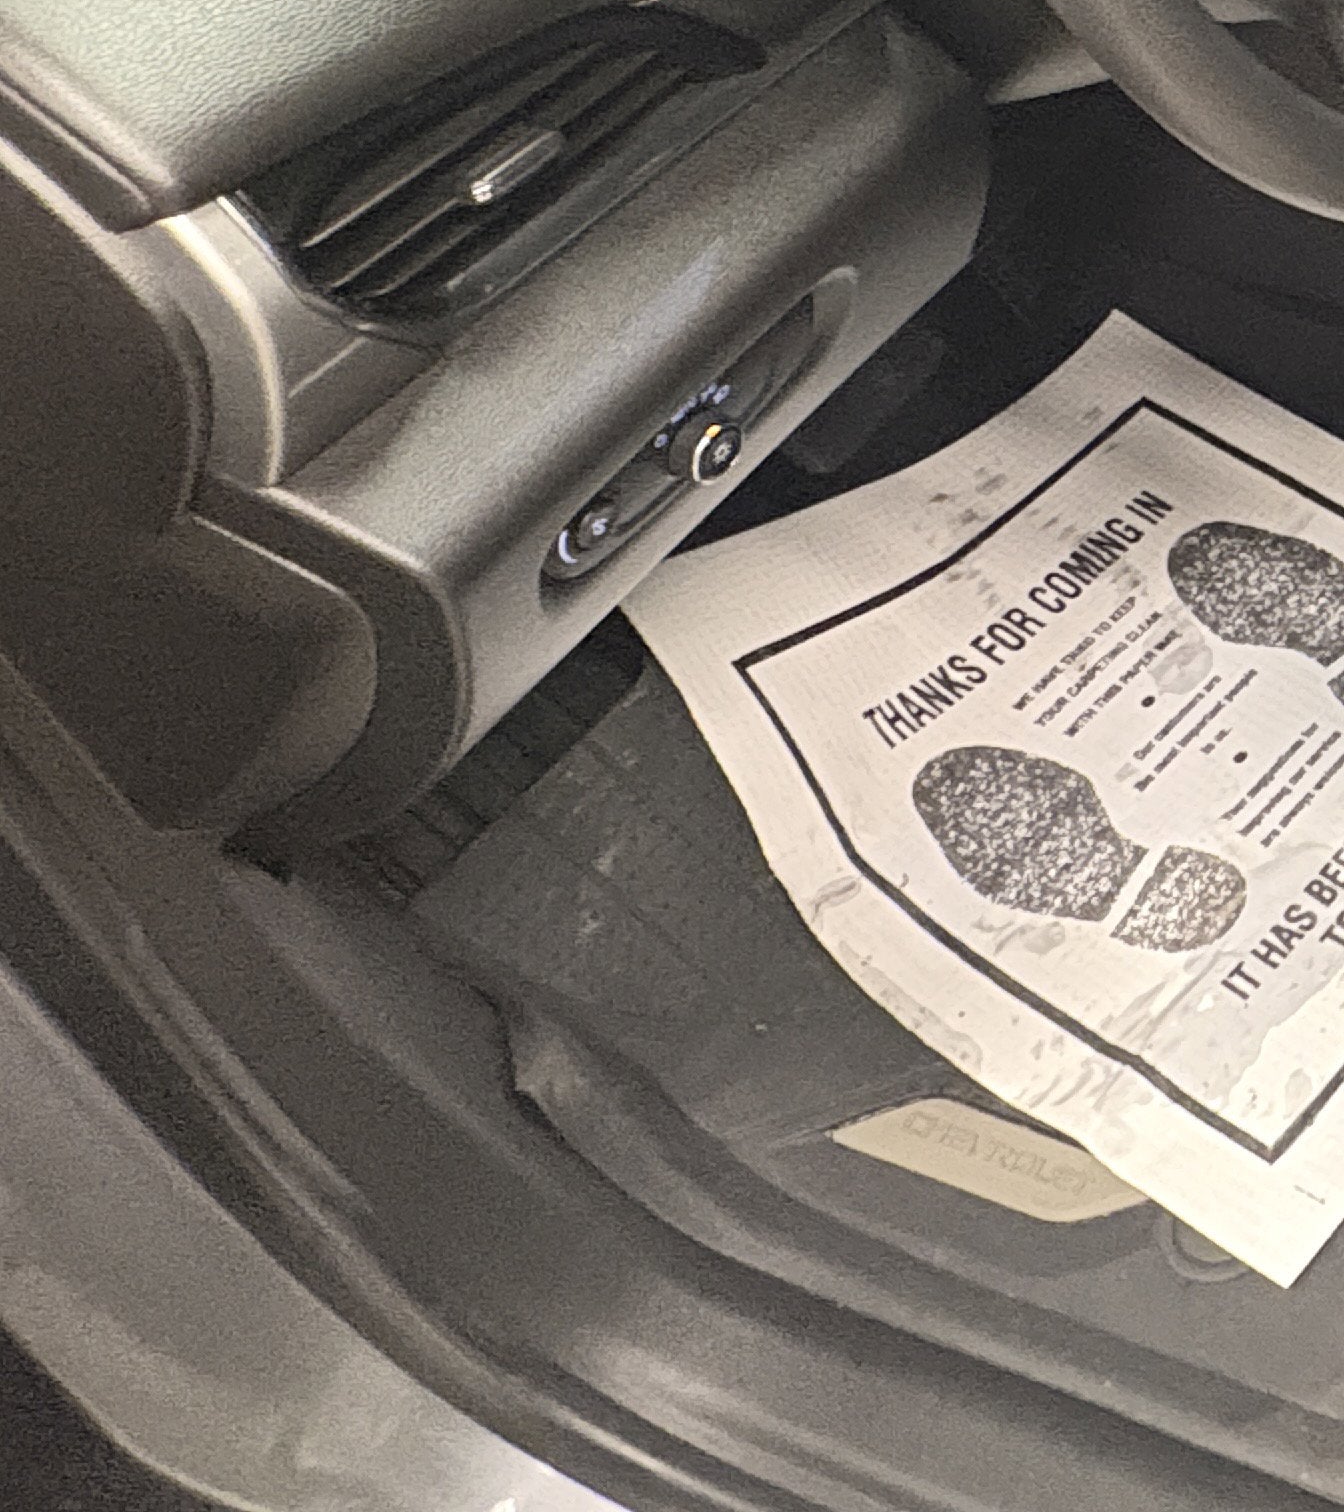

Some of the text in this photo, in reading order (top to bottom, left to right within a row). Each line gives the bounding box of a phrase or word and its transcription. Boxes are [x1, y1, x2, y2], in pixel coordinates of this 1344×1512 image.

[861, 489, 1174, 750] THANKS FOR COMING IN
[1091, 620, 1113, 636] TO
[1033, 695, 1072, 727] YOUR
[1062, 707, 1099, 739] WITH
[1118, 650, 1158, 685] PAPER
[1220, 960, 1262, 1001] IT
[1250, 903, 1319, 970] HAS
